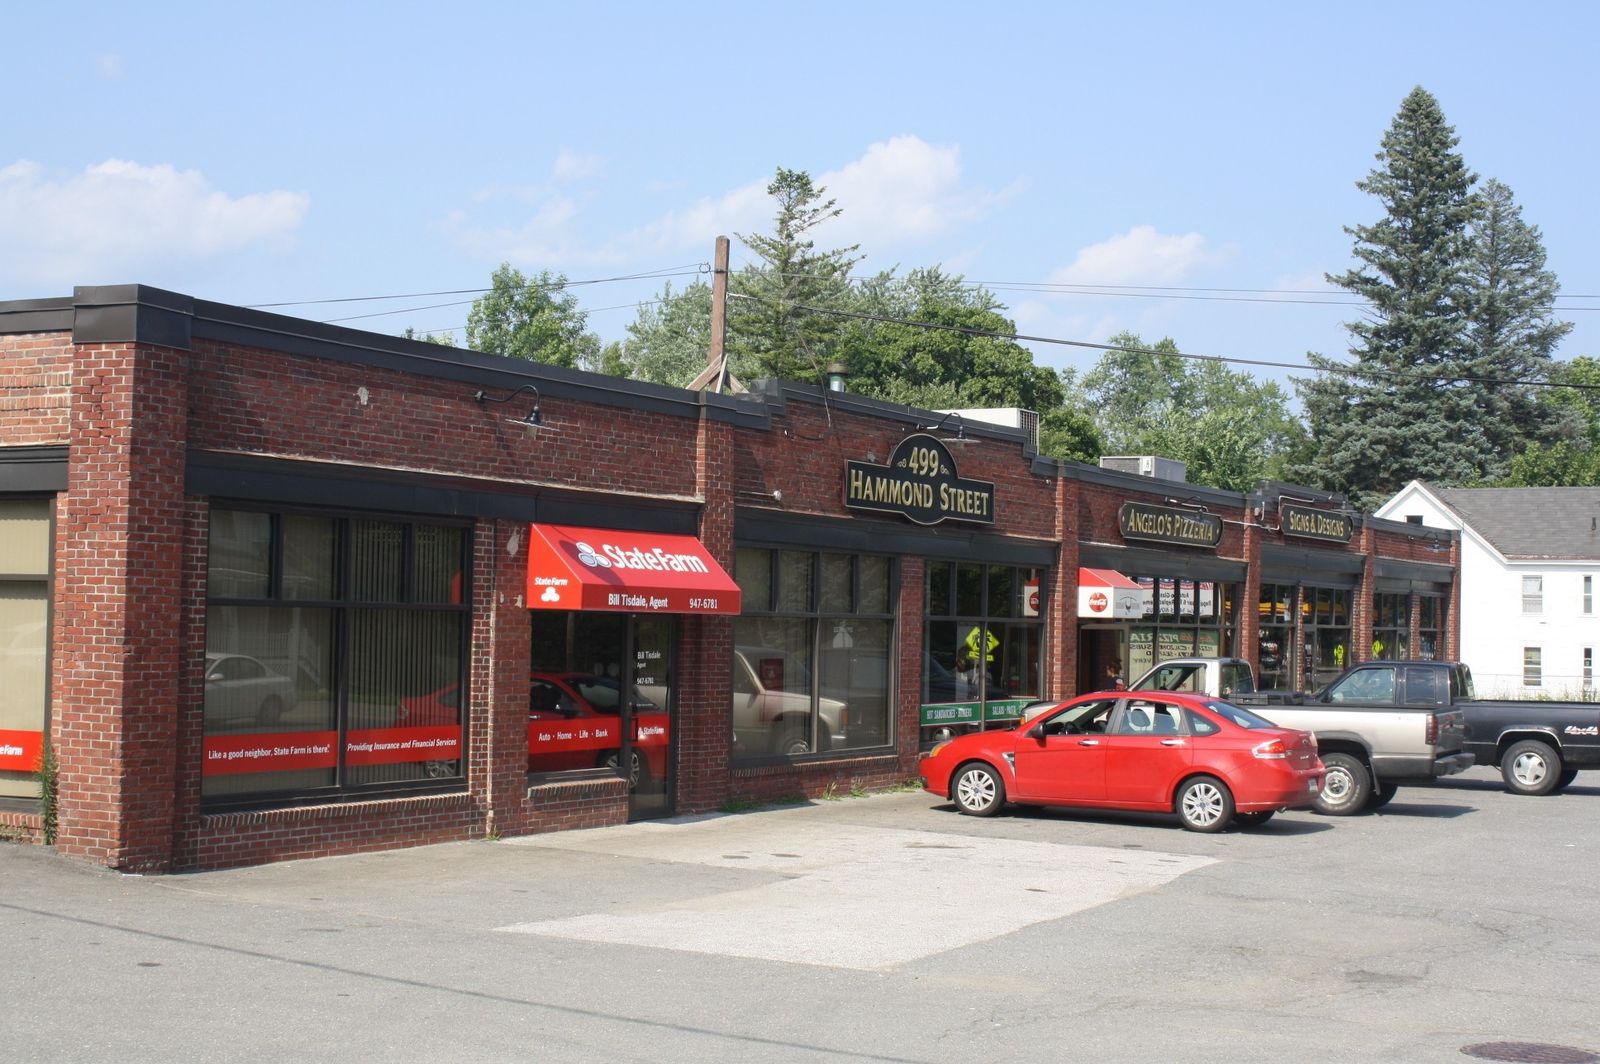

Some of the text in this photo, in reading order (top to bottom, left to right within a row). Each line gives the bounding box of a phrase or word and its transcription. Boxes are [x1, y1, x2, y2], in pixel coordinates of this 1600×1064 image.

[909, 446, 939, 478] 499
[850, 469, 989, 515] HAMMOND STREET
[1127, 508, 1213, 540] ANGELO'S PIZZERIA
[1289, 510, 1309, 532] SIGNS
[1317, 514, 1344, 537] DESIGNS
[602, 544, 709, 573] StateFarm
[608, 593, 718, 609] Bill Tisdale, Agent 947-6781
[538, 728, 608, 742] Auto Home Life Bank
[1564, 725, 1599, 736] 4x4
[208, 750, 221, 759] Like
[228, 749, 243, 760] good
[273, 747, 289, 756] State
[290, 745, 306, 755] Farm
[306, 745, 312, 754] is
[347, 738, 457, 752] Providing Insurance and Financial Services
